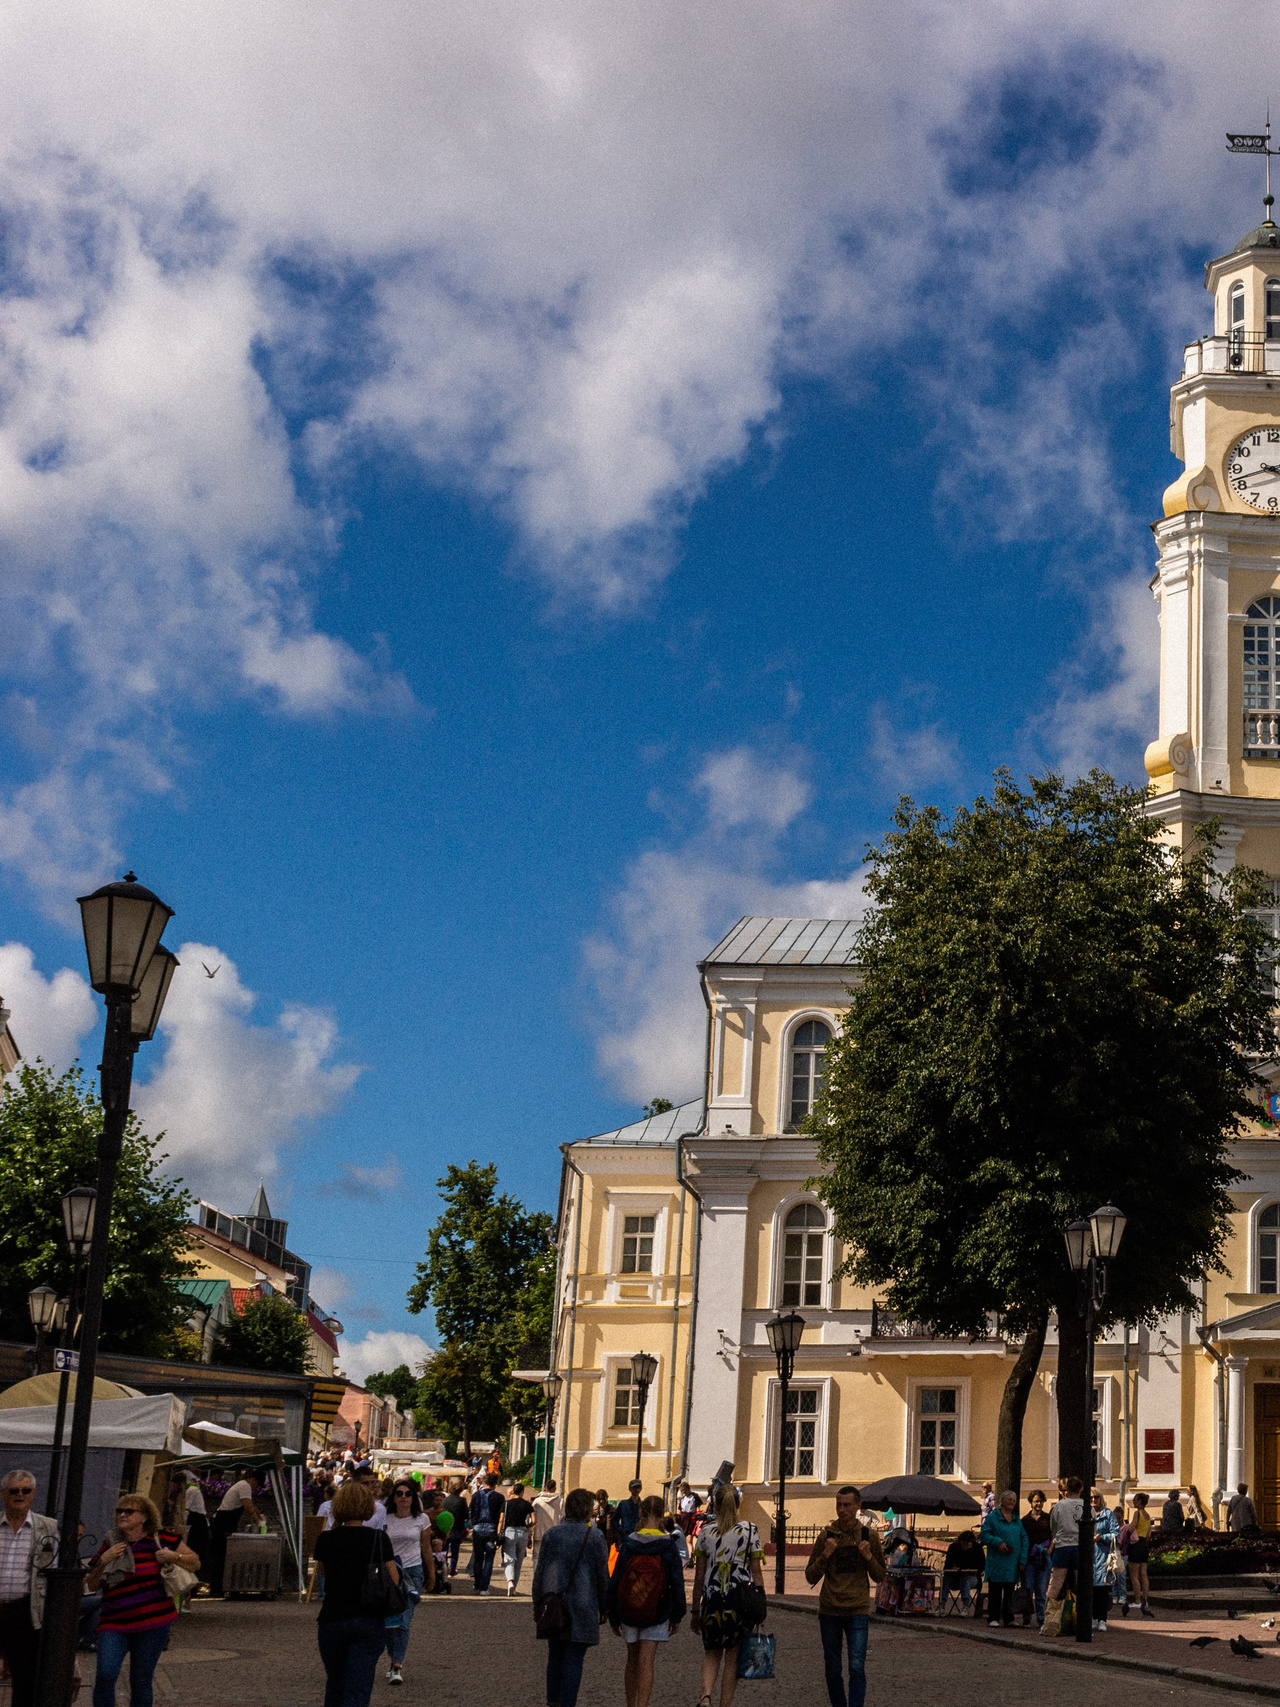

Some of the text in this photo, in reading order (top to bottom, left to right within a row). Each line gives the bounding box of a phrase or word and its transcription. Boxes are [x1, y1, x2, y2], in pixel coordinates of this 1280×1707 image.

[1252, 435, 1261, 446] 11
[1267, 432, 1280, 443] 12
[1237, 447, 1250, 457] 10
[1232, 464, 1242, 474] 9
[1237, 480, 1247, 490] 8
[1250, 493, 1260, 502] 7
[1267, 497, 1278, 507] 6
